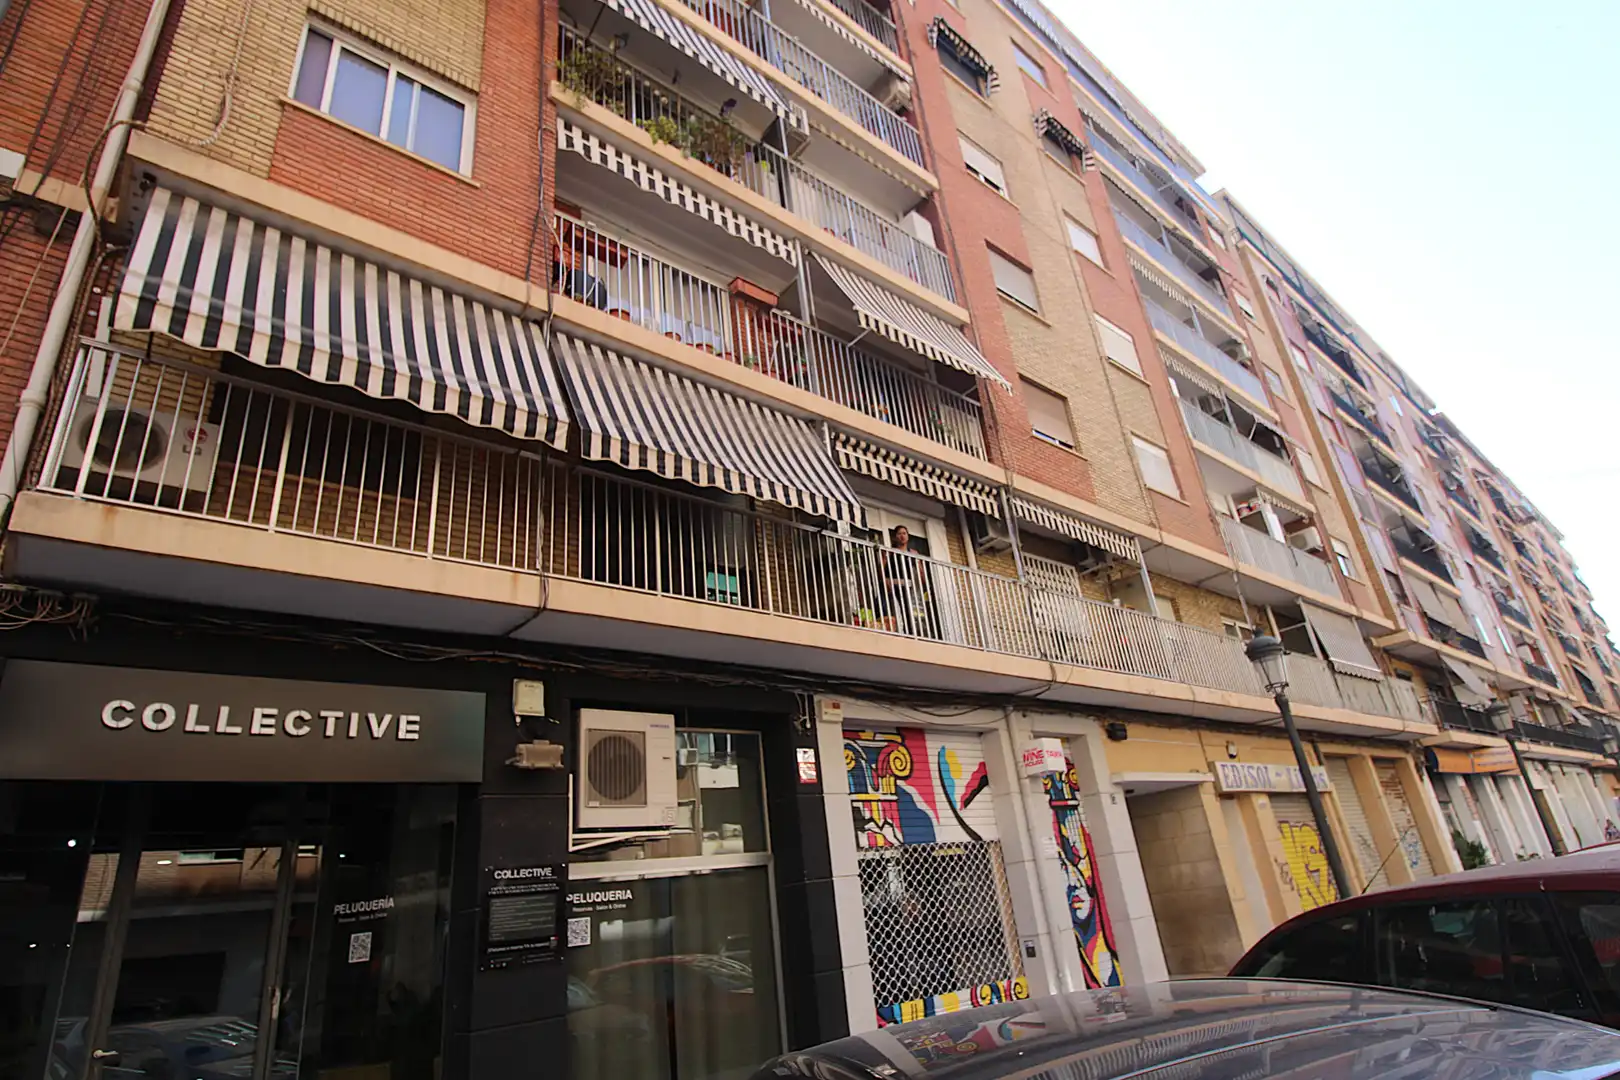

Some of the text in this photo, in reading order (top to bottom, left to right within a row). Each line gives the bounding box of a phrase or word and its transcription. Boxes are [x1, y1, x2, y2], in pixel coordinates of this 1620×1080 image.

[101, 699, 421, 740] COLLECTIVE
[1220, 763, 1276, 789] EDISOL
[494, 867, 553, 880] COLLECTIVE
